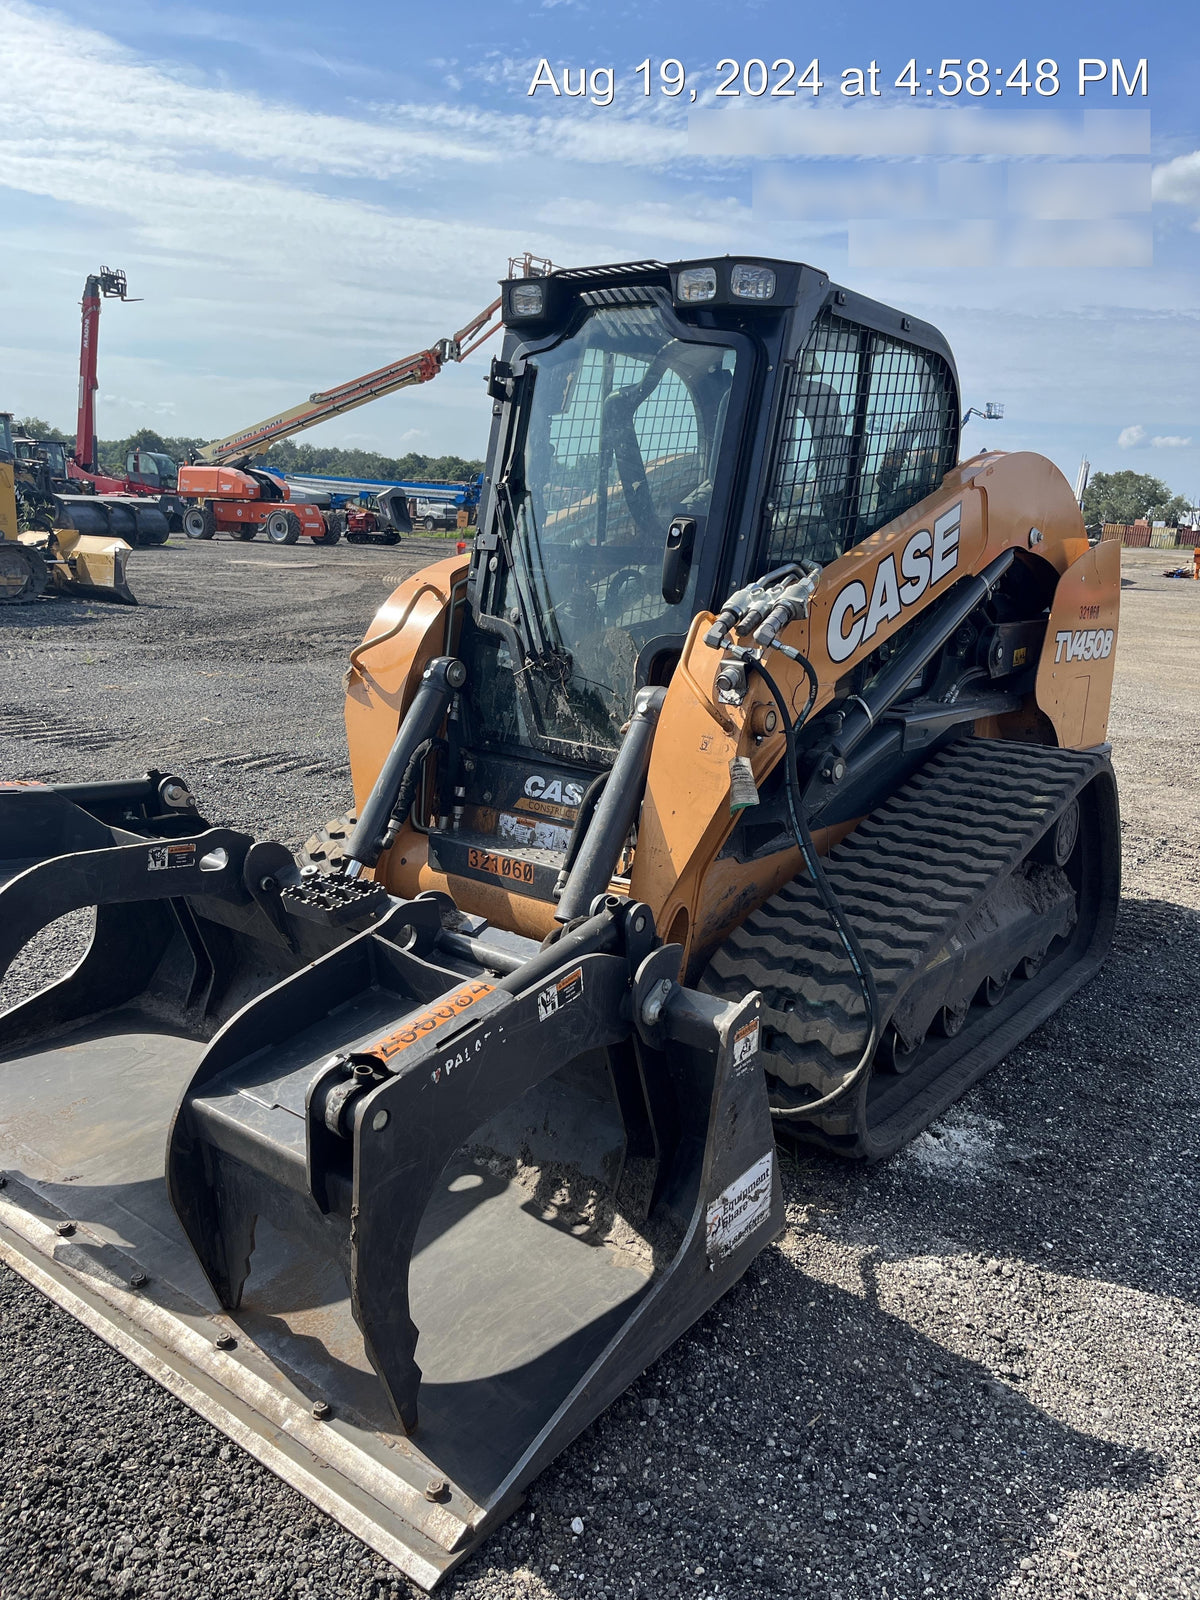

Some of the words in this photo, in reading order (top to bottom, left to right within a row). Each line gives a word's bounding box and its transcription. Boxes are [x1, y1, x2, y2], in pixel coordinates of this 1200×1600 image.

[826, 500, 963, 664] CASE
[1054, 628, 1114, 664] TV450B
[524, 775, 584, 806] CAS
[528, 801, 577, 818] CONSTRUCT
[470, 849, 533, 881] 321060
[723, 1168, 770, 1216] Equipment
[722, 1201, 748, 1229] Share
